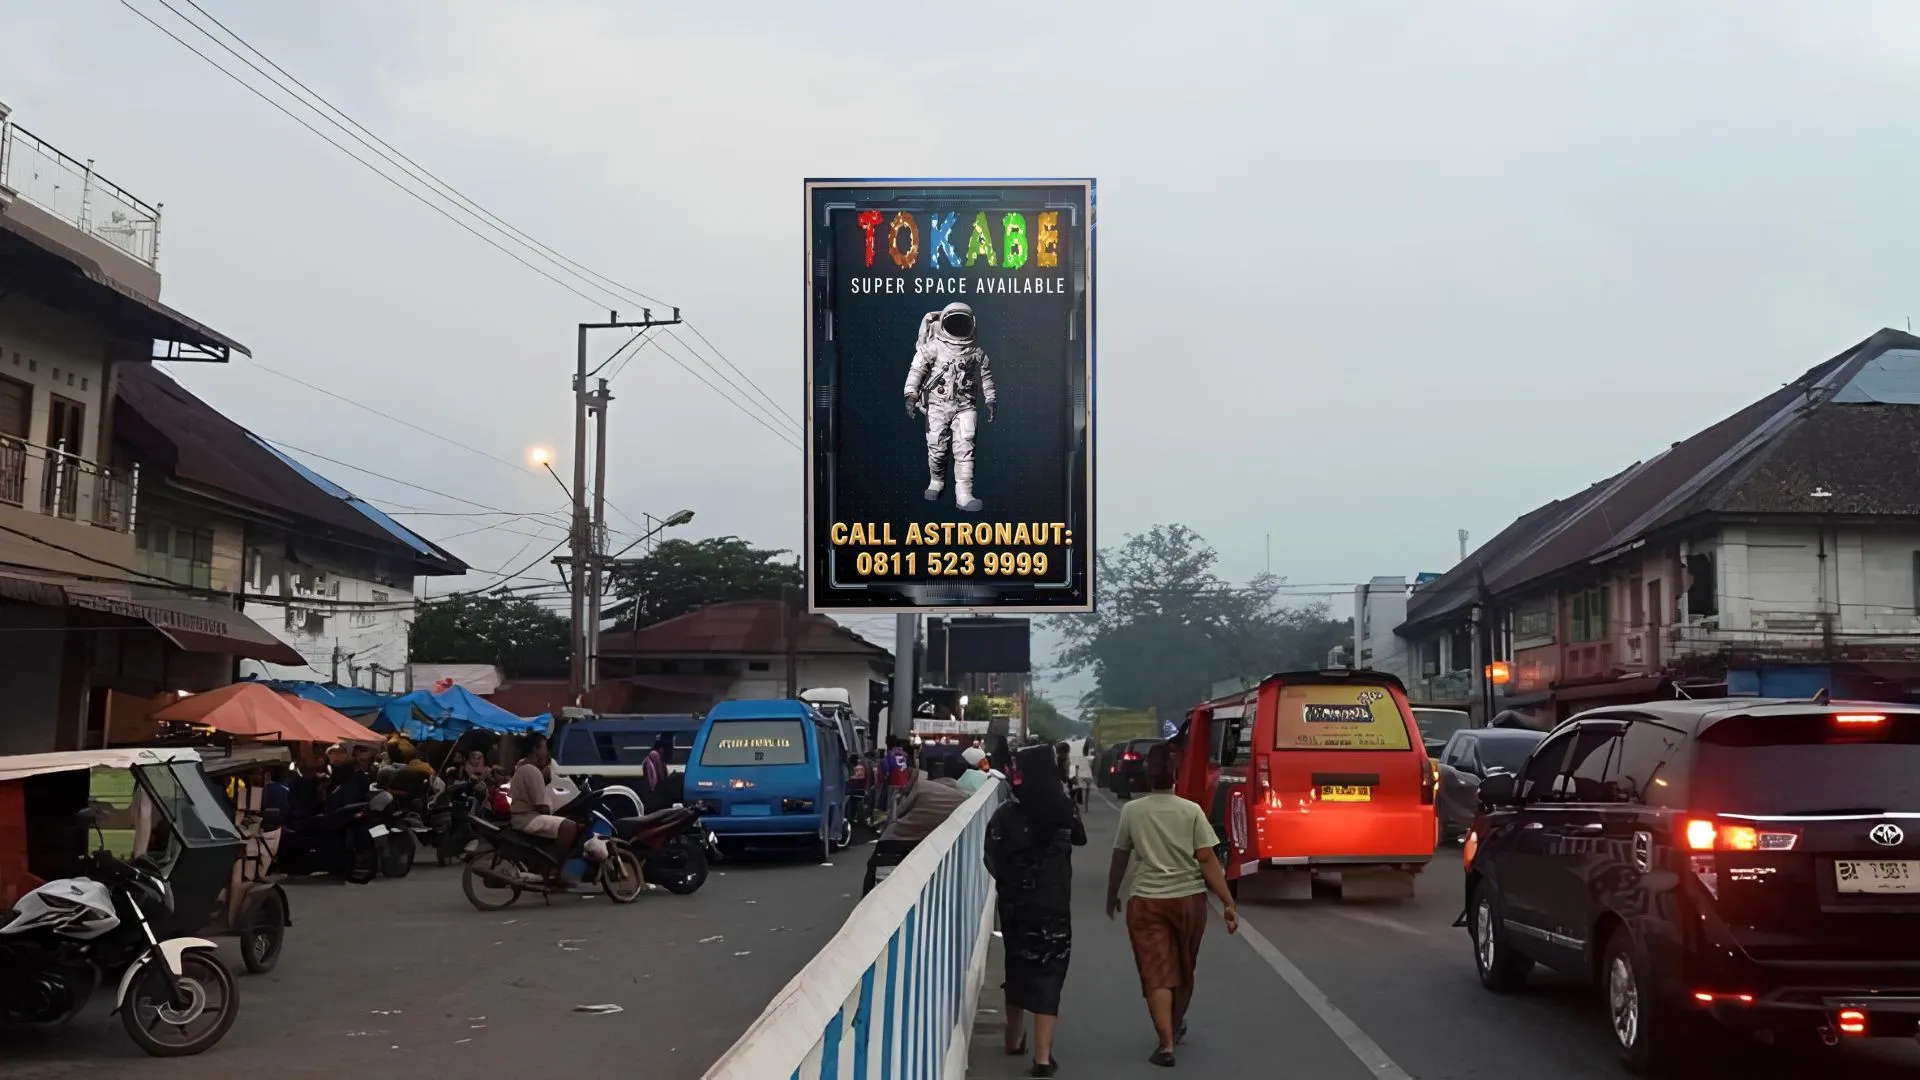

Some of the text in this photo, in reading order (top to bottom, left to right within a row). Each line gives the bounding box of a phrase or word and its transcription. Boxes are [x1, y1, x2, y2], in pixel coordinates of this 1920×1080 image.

[857, 209, 1060, 270] TOKABE
[851, 277, 1065, 294] SUPER SPACE AVAILABLE
[831, 522, 1073, 546] CALL ASTRONAUT:
[856, 551, 1048, 576] 0811 523 9999
